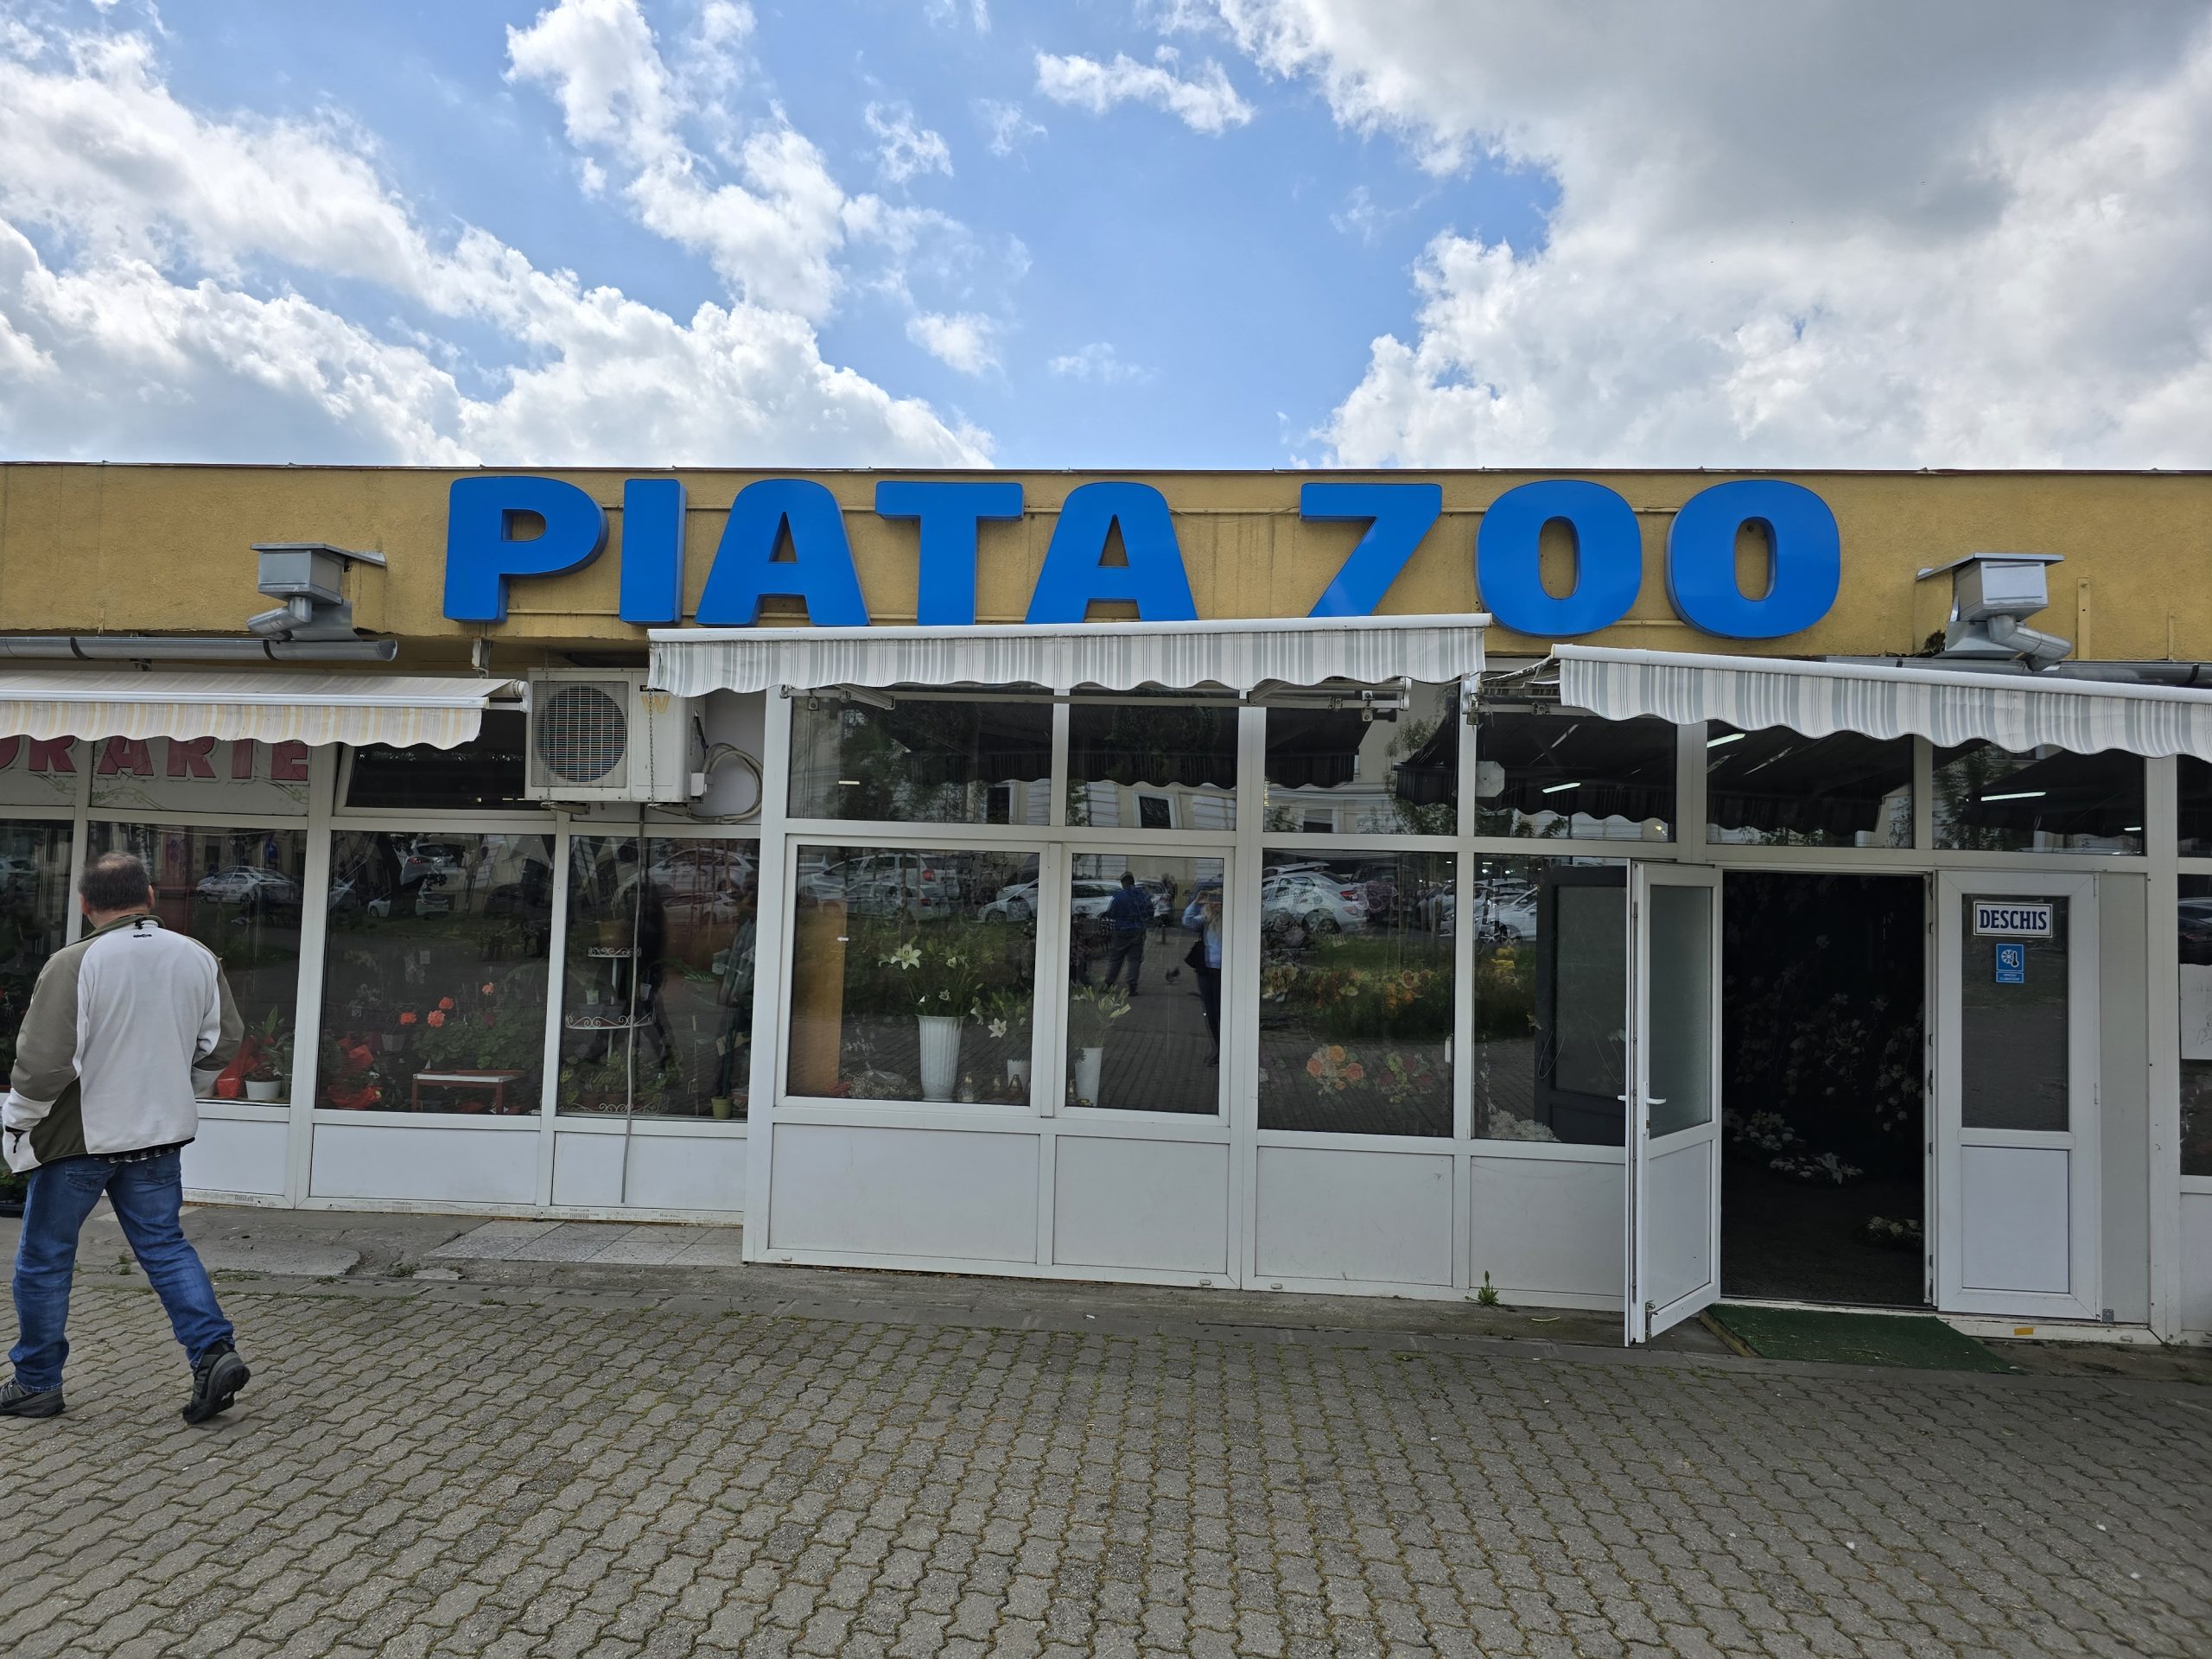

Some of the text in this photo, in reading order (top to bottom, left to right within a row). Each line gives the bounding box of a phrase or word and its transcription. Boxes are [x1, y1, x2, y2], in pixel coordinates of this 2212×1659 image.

[444, 475, 1841, 639] PIATA 700
[1979, 909, 2048, 931] DESCHIS
